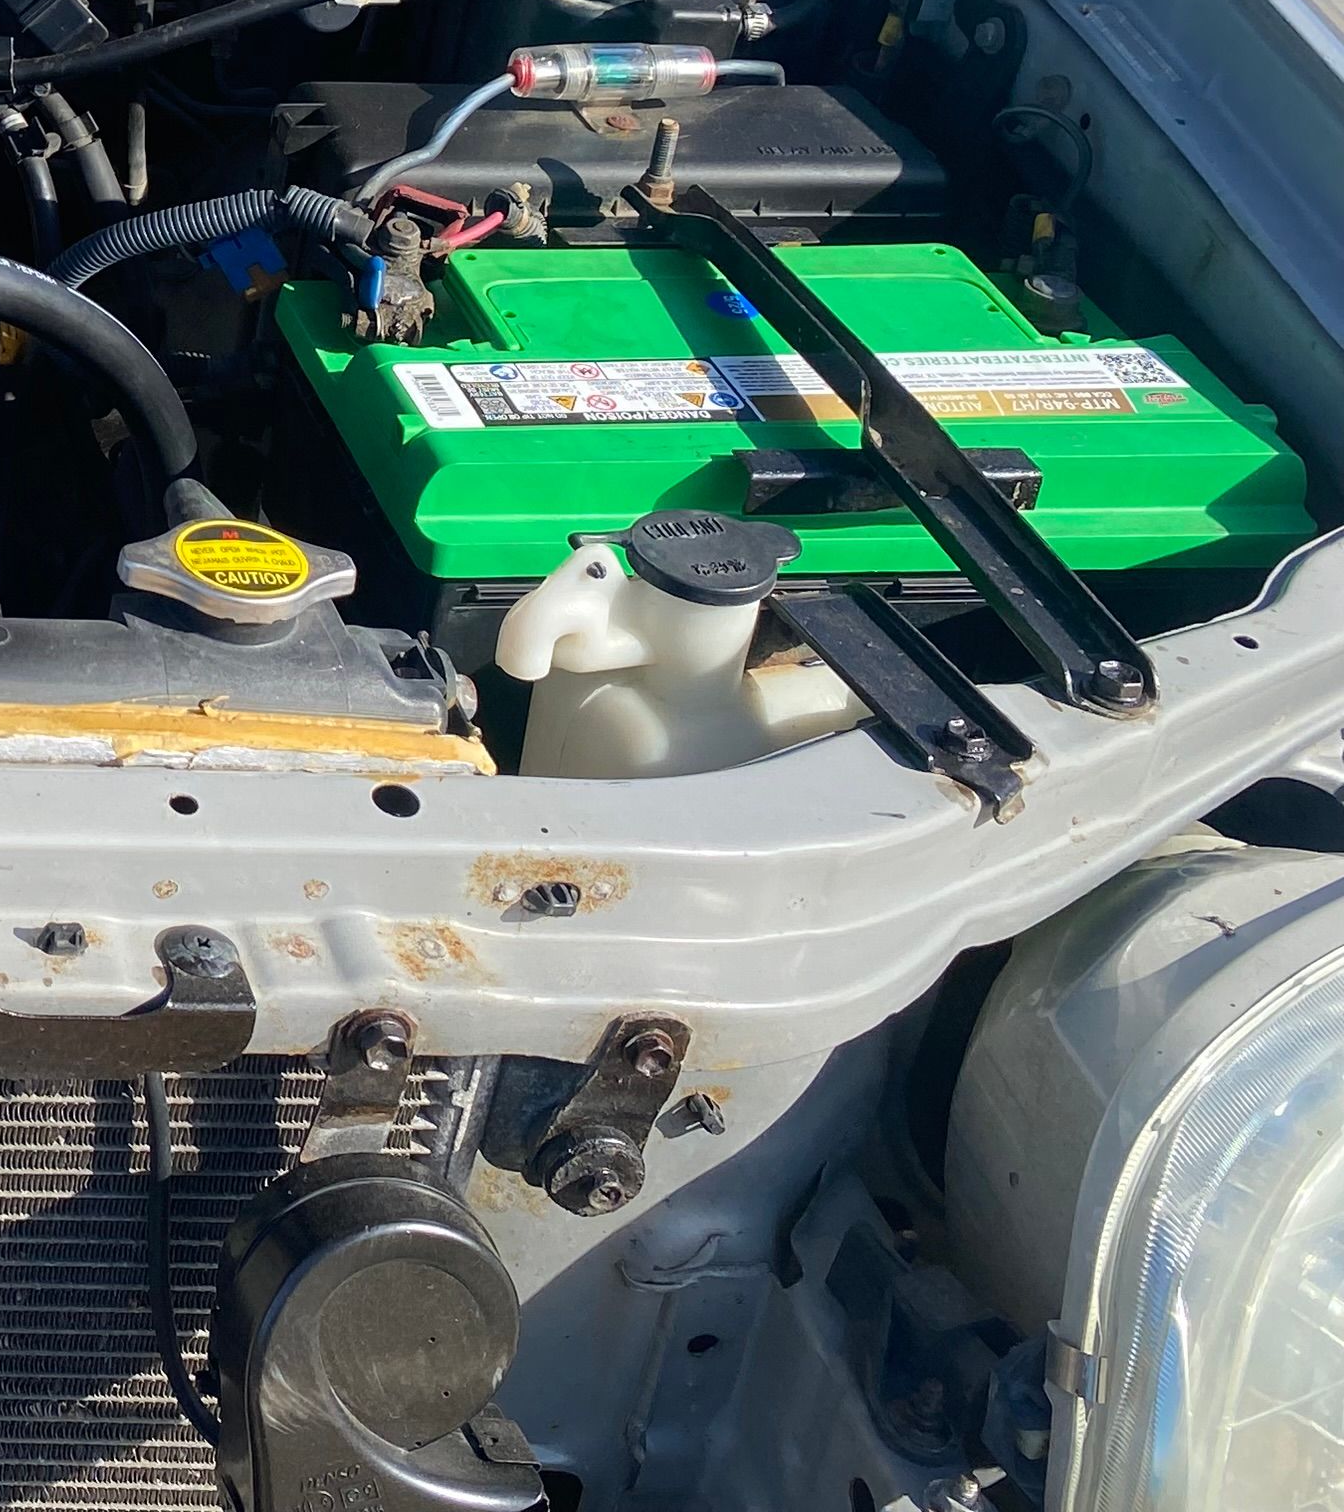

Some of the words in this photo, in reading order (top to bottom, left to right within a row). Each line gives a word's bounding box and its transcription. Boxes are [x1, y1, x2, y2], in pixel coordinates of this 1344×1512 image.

[1011, 397, 1121, 412] MTP-94R/H7
[583, 409, 712, 422] DANGER/POISON
[641, 516, 725, 541] COOLANT
[214, 570, 290, 585] CAUTION
